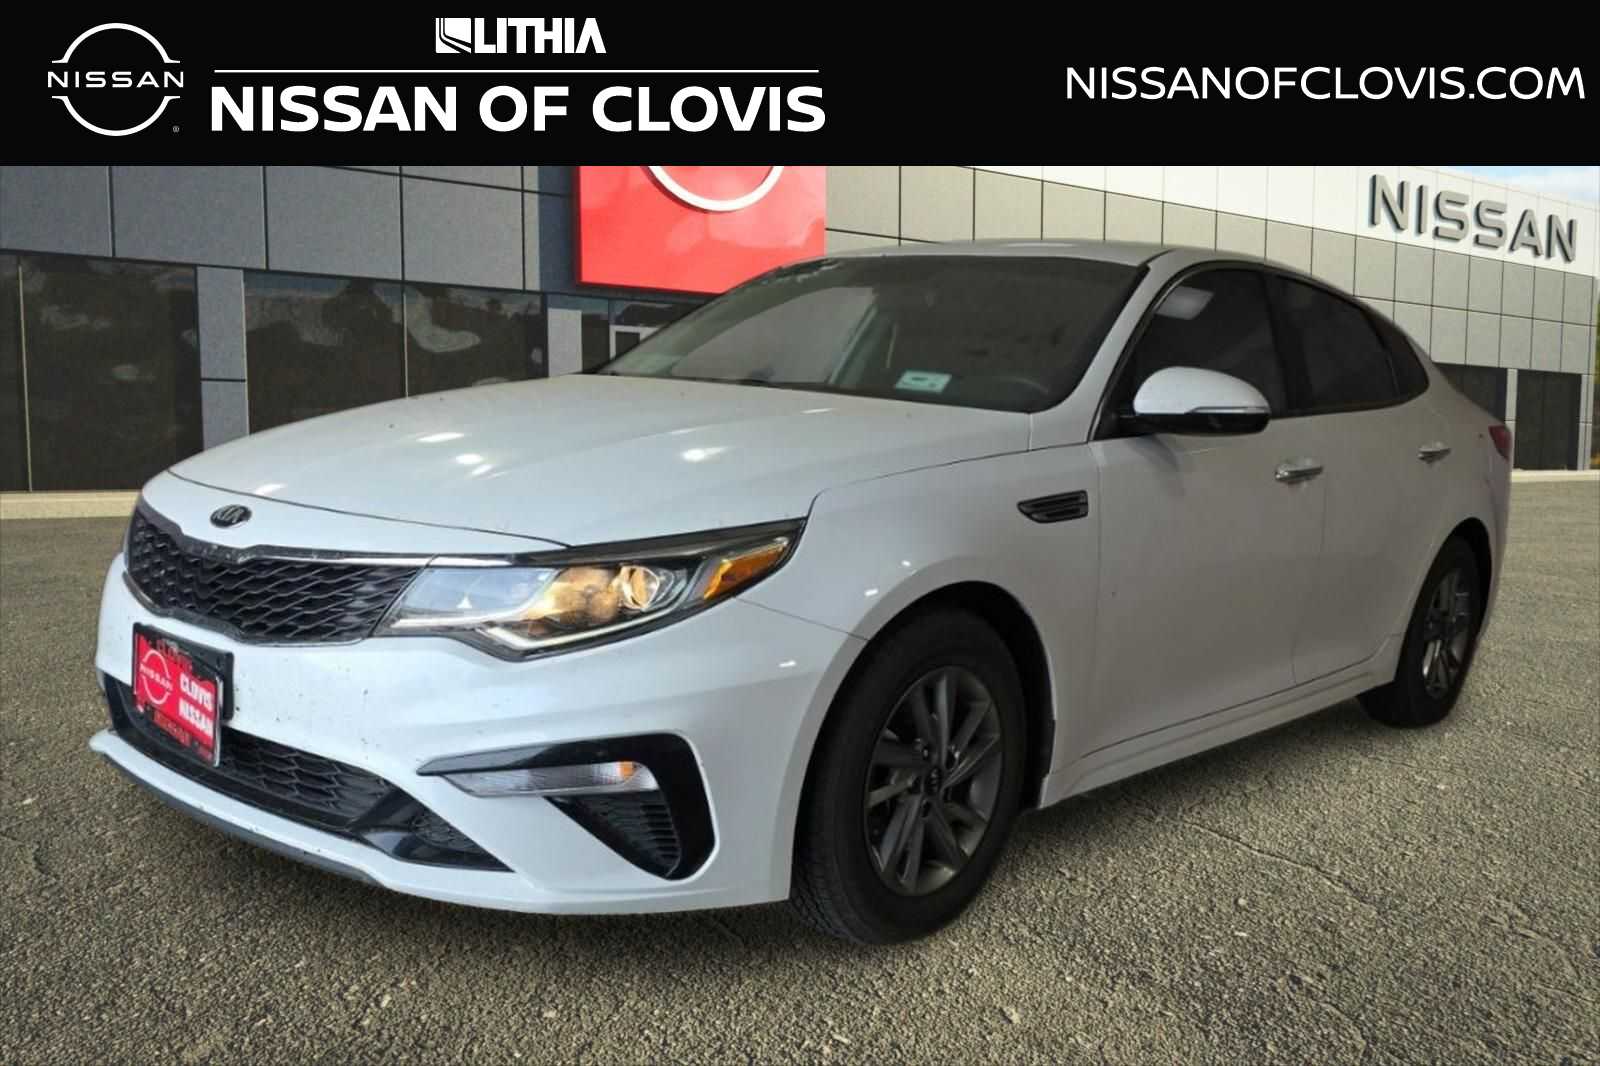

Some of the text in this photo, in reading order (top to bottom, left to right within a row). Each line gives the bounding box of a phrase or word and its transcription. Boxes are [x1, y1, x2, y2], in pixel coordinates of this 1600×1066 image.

[1369, 174, 1577, 263] NISSAN
[179, 671, 214, 712] CLOVIS
[178, 697, 214, 738] NISSAN
